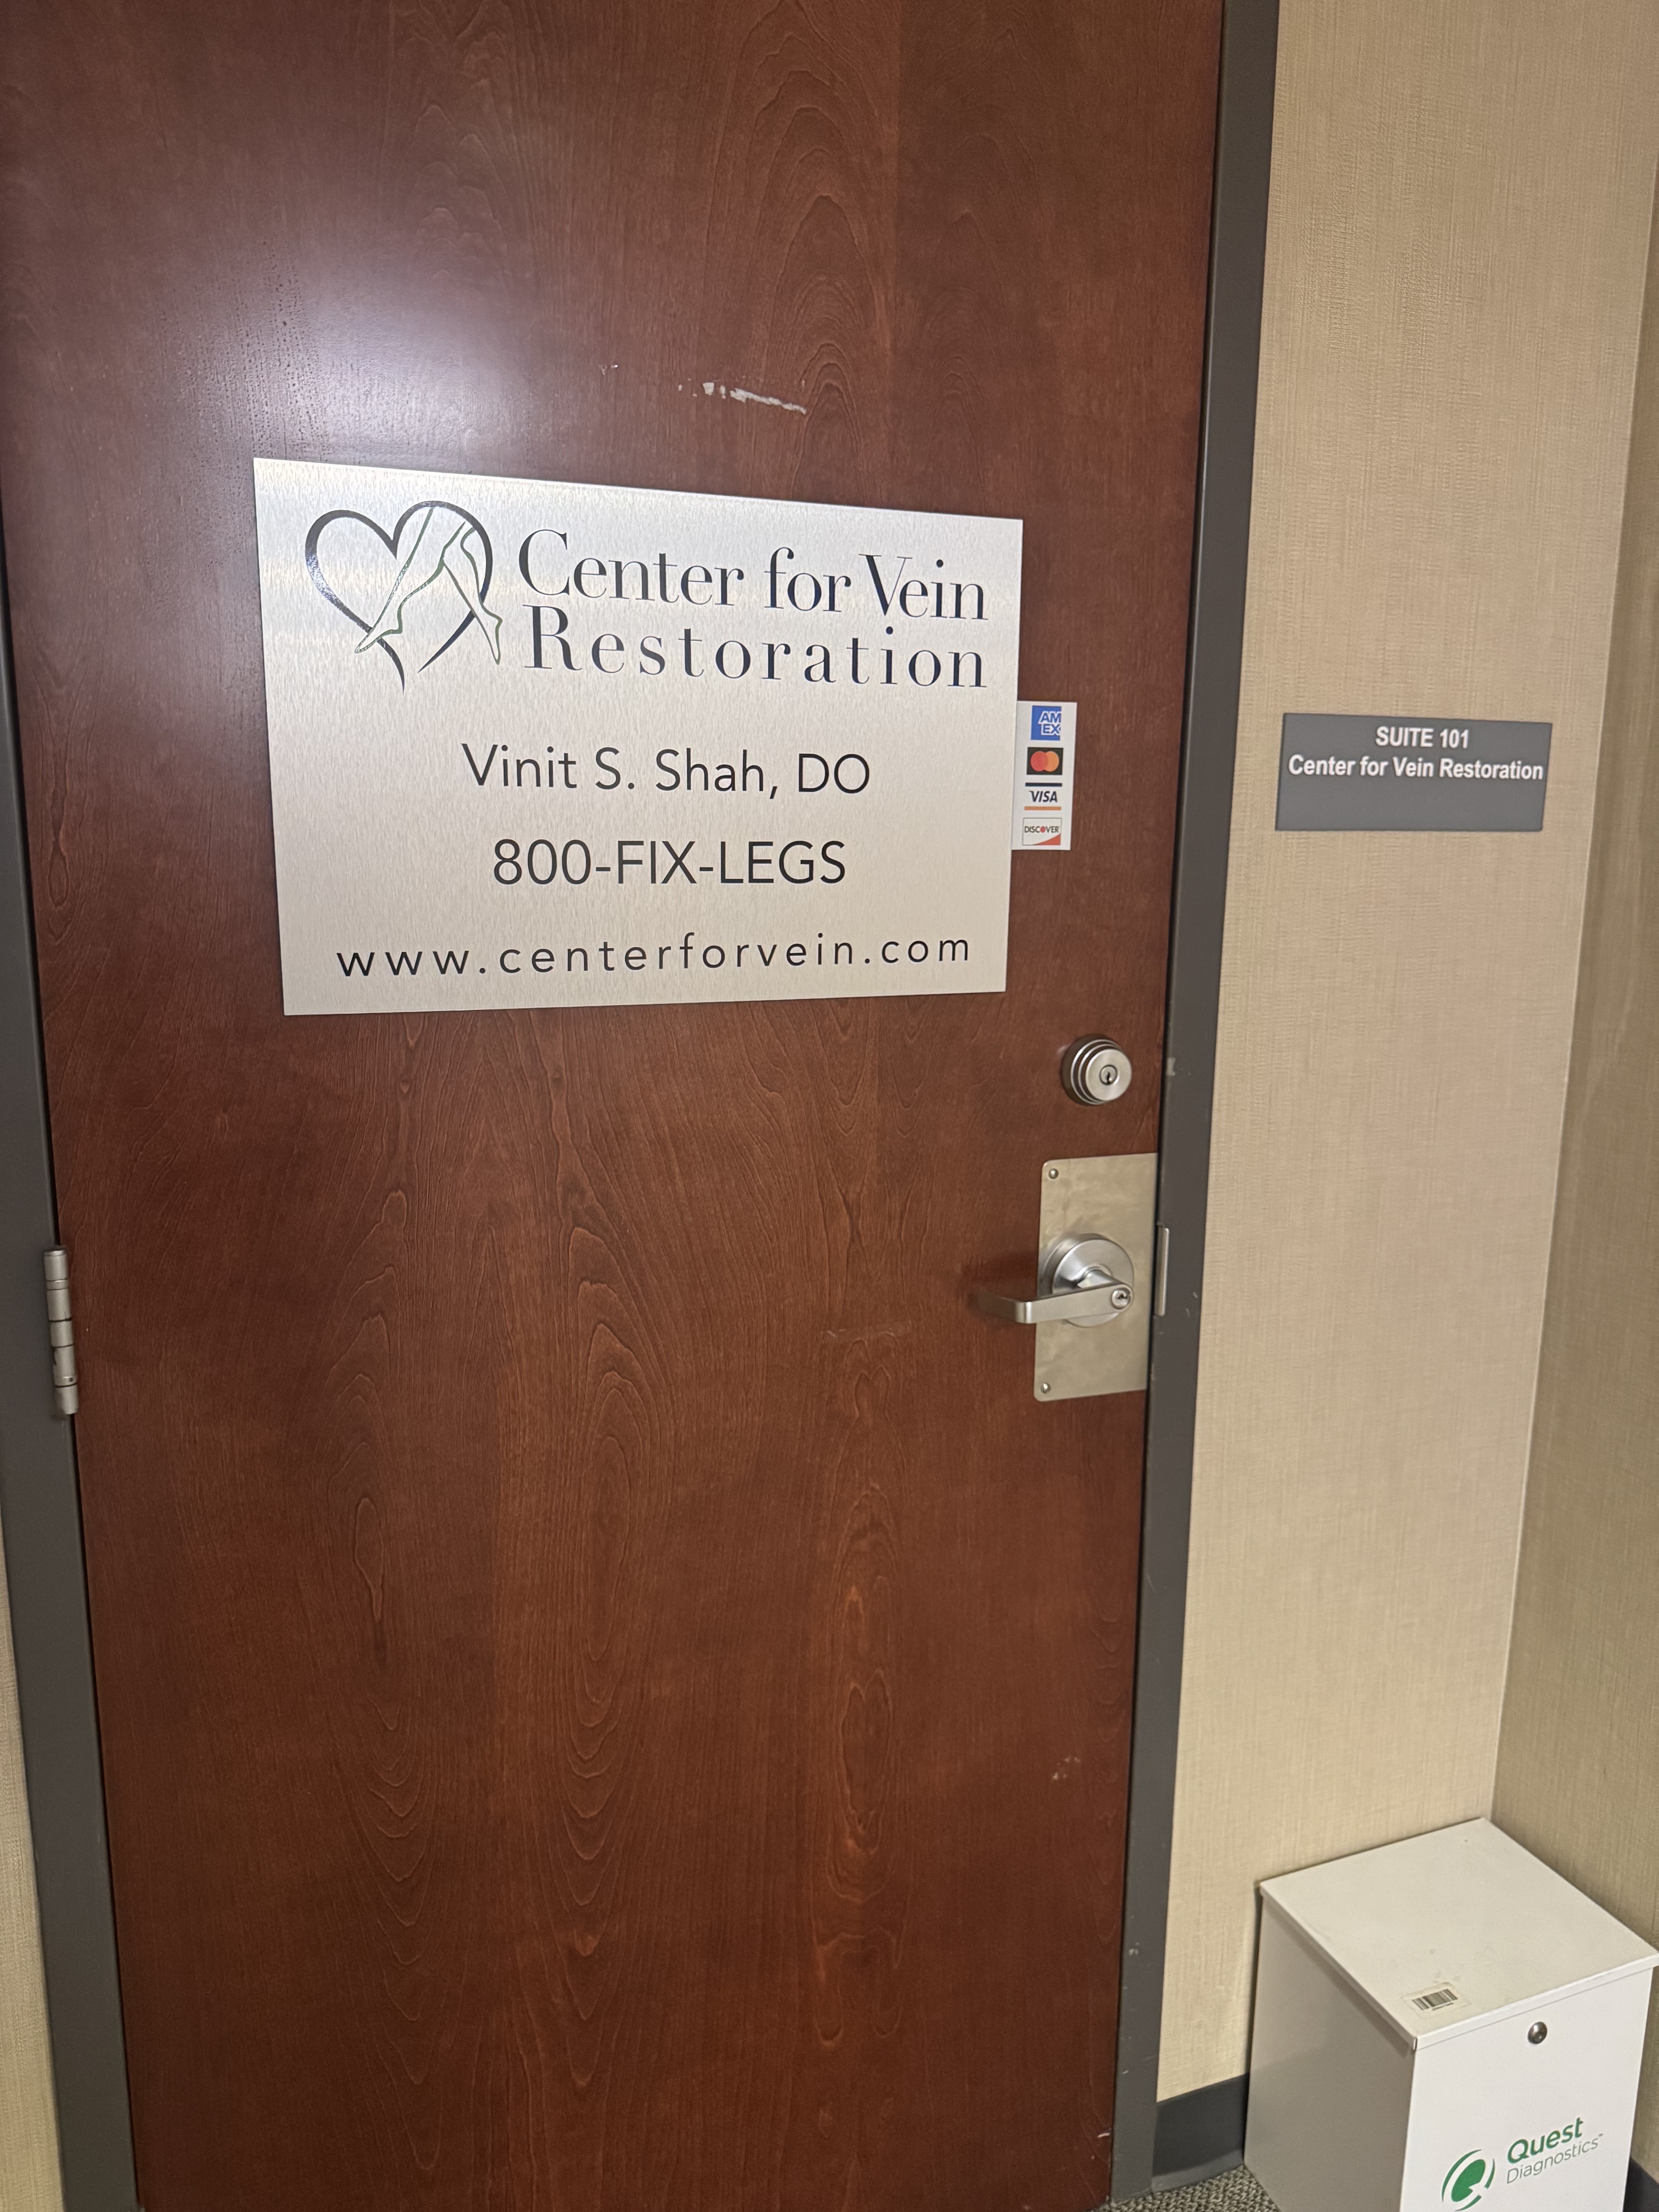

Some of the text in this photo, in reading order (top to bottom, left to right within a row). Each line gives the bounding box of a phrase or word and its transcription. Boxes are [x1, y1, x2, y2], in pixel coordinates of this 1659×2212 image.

[518, 529, 989, 620] Center for Vein
[522, 604, 988, 688] Restoration
[1375, 726, 1469, 749] SUITE 101
[461, 743, 870, 800] Vinit S. Shah, DO
[1288, 754, 1544, 780] Center for Vein Restoration
[1029, 790, 1058, 803] VISA
[493, 838, 846, 885] 800-FIX-LEGS
[336, 932, 969, 977] www.centerforvein.com
[1507, 2117, 1584, 2164] Quest
